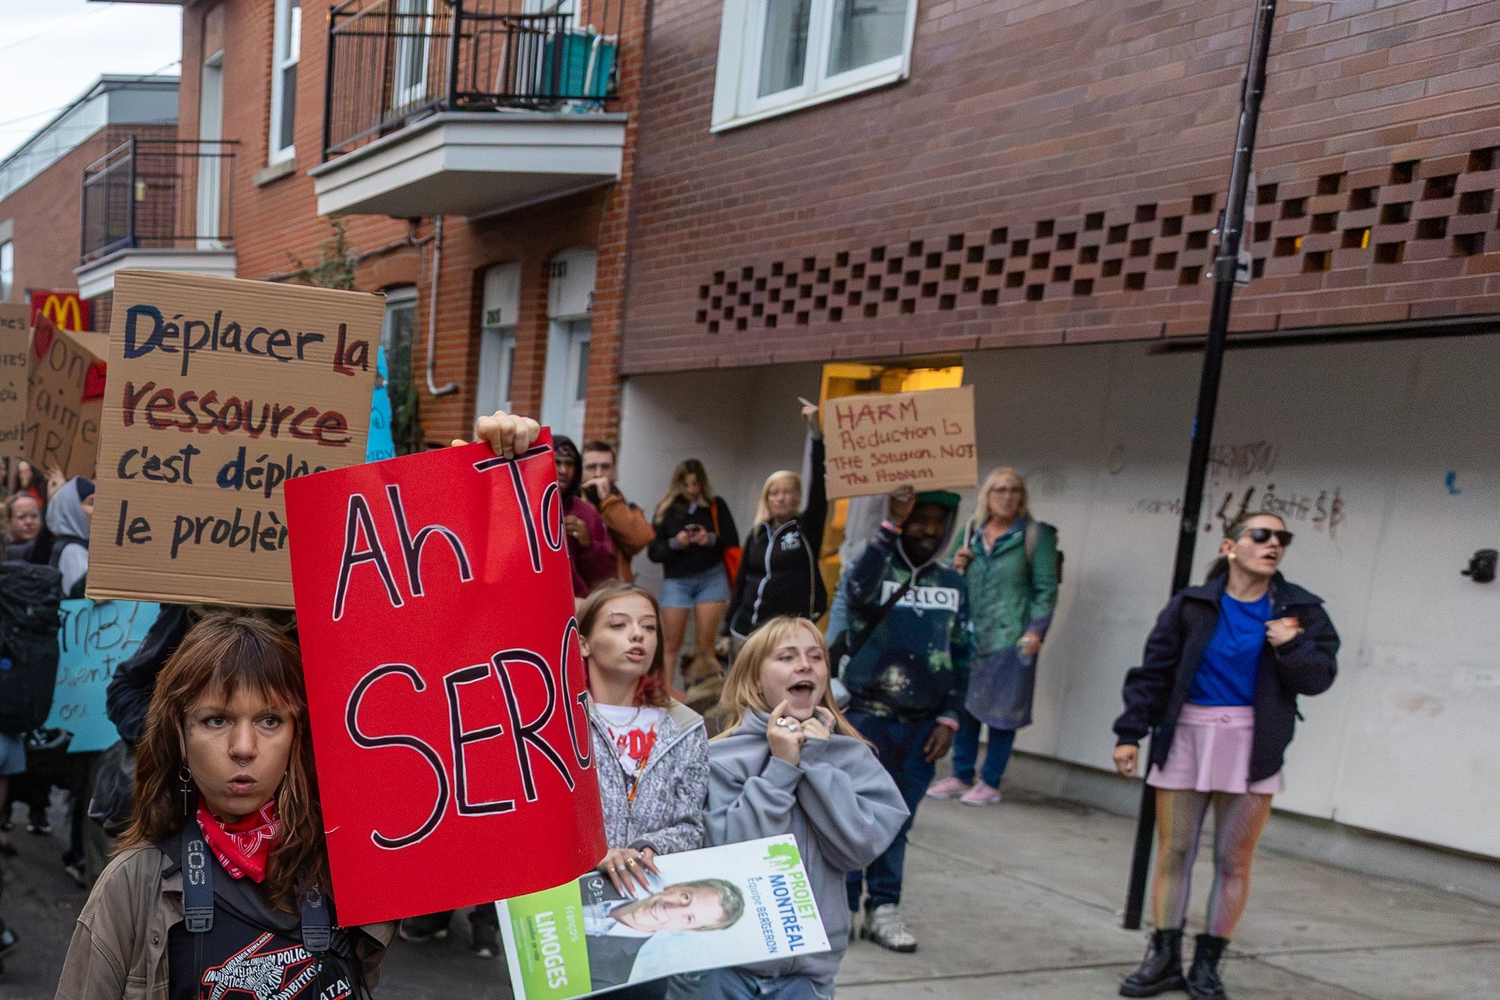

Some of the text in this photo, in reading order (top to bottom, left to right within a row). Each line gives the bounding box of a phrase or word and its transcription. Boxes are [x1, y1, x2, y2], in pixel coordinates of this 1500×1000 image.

[123, 304, 325, 377] Déplacer
[123, 381, 353, 448] ressource
[835, 397, 919, 431] HARM
[117, 443, 202, 485] c'est
[828, 455, 864, 470] THE
[939, 443, 975, 459] NOT
[115, 500, 153, 547] le
[332, 484, 472, 621] Ah
[768, 874, 805, 952] MONTRÉAL
[788, 871, 817, 920] PROJET
[534, 911, 569, 990] LIMOGES
[756, 906, 779, 955] BERGERON
